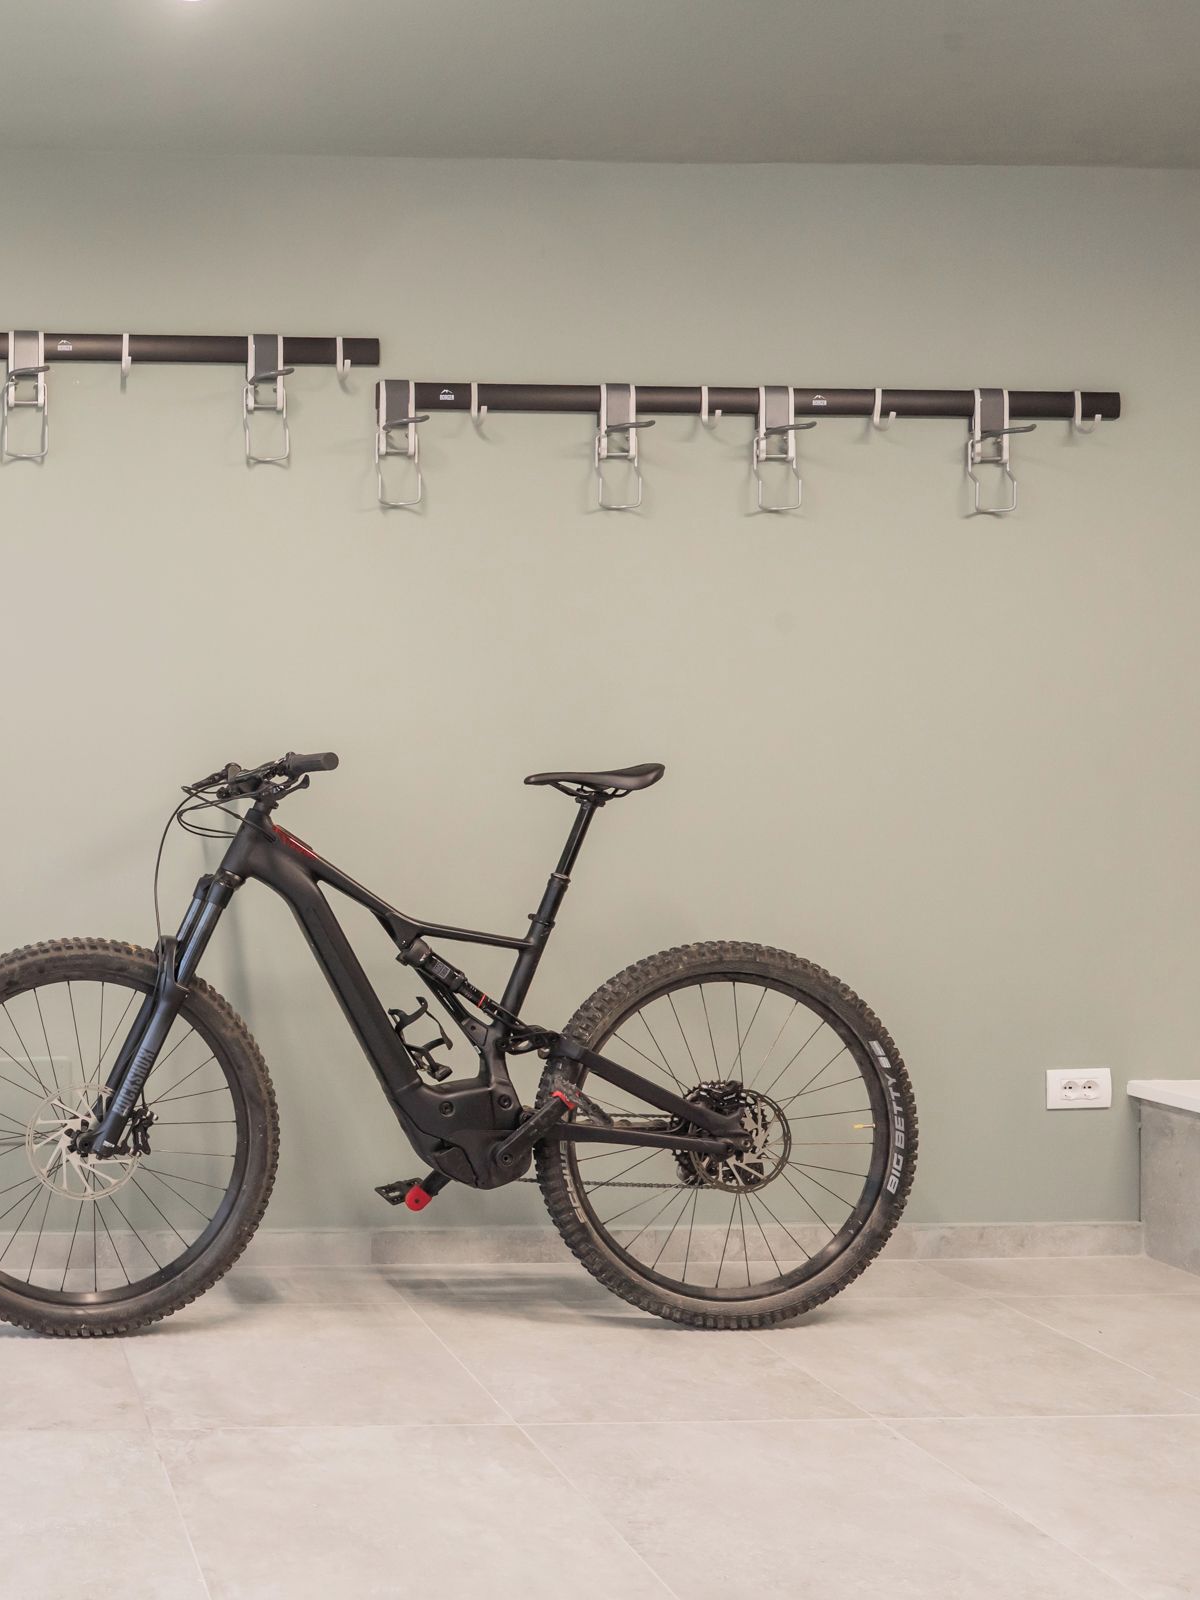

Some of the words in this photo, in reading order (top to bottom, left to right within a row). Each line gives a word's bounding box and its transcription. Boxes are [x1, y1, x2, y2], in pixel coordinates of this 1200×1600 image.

[112, 1048, 155, 1116] ROCKSHOX
[884, 1073, 905, 1149] BETTY
[886, 1153, 903, 1194] BIG
